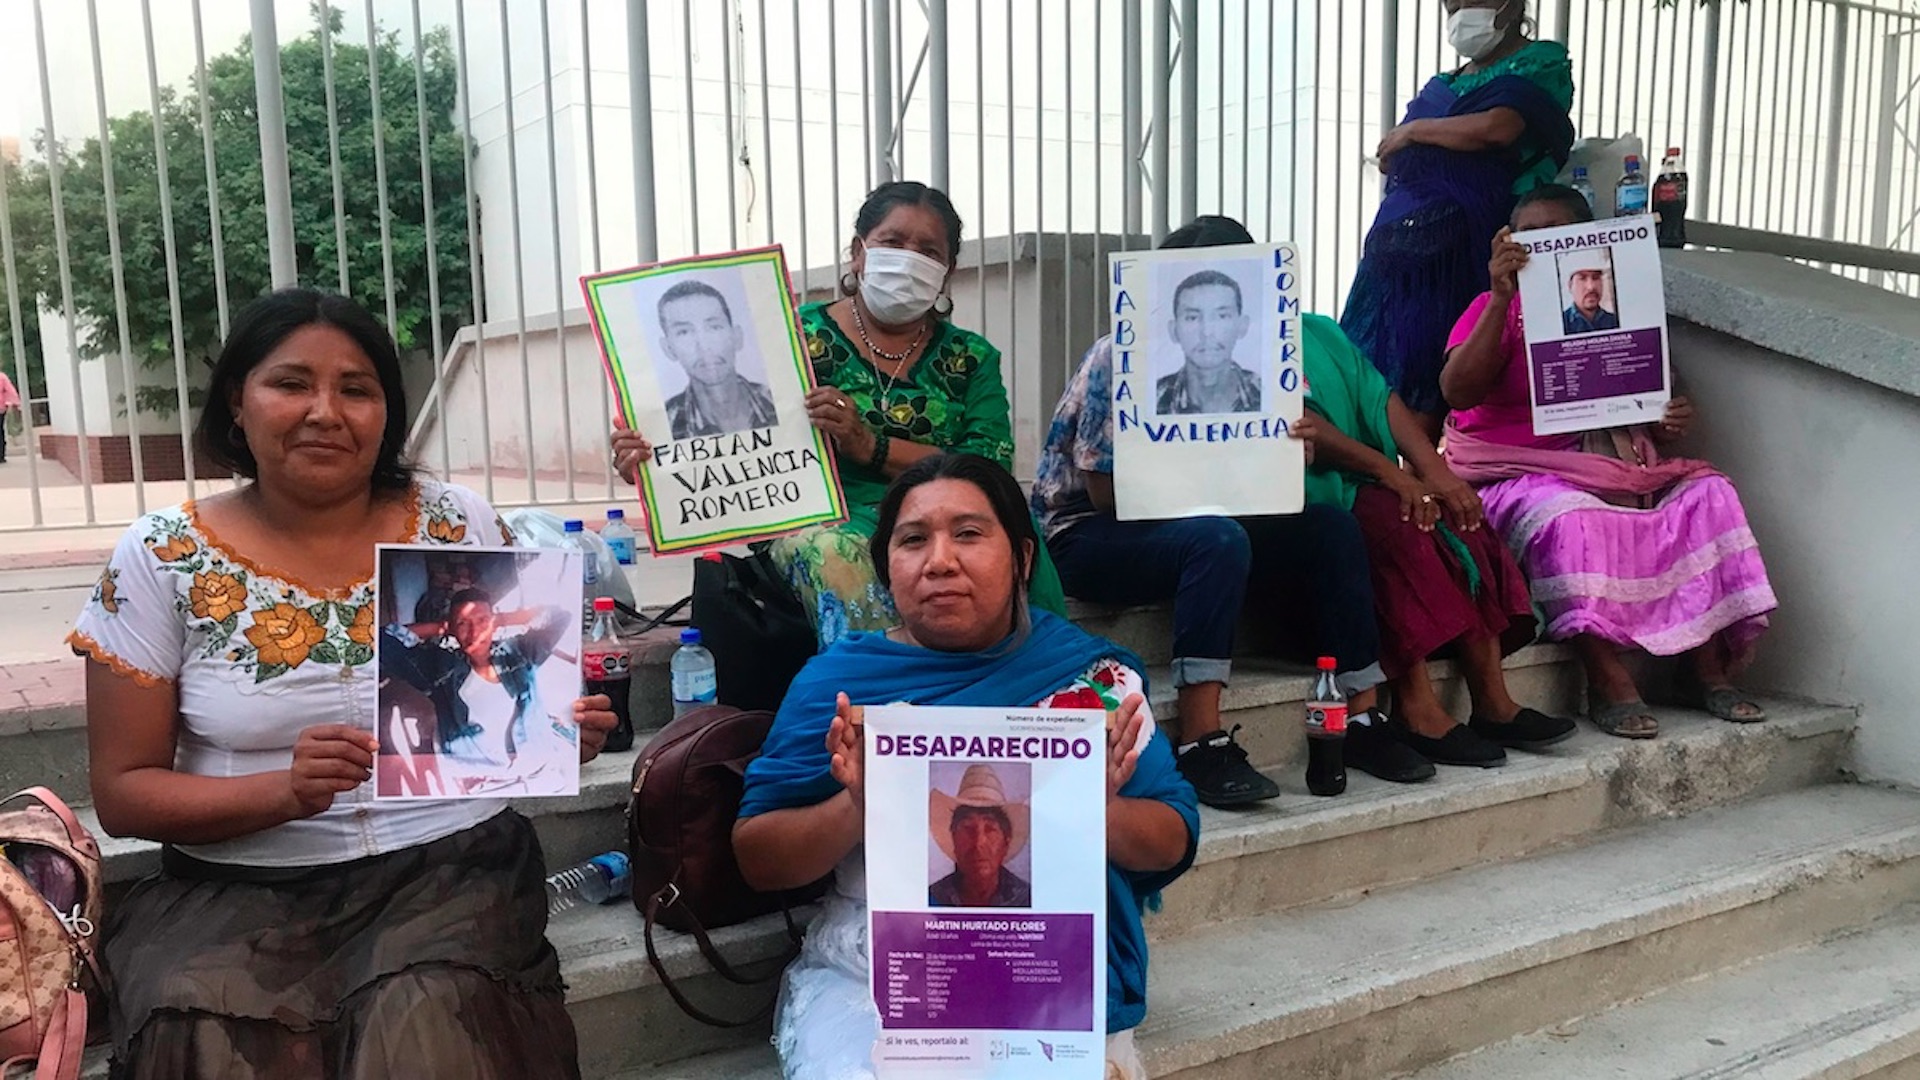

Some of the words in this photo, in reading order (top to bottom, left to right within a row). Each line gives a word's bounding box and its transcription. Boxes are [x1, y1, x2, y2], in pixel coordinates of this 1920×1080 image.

[1274, 247, 1299, 393] ROMERO
[1113, 258, 1139, 432] FABIAN
[1143, 418, 1290, 442] VALENCIA
[653, 428, 773, 467] FABIAN
[672, 449, 822, 495] VALENCIA
[679, 481, 801, 525] ROMERO
[1036, 714, 1044, 722] de
[876, 735, 1091, 759] DESAPARECIDO
[925, 920, 960, 931] MARTIN
[962, 920, 1009, 931] HURTADO
[1010, 920, 1047, 932] FLORES
[886, 1036, 893, 1045] Si
[895, 1036, 902, 1045] le
